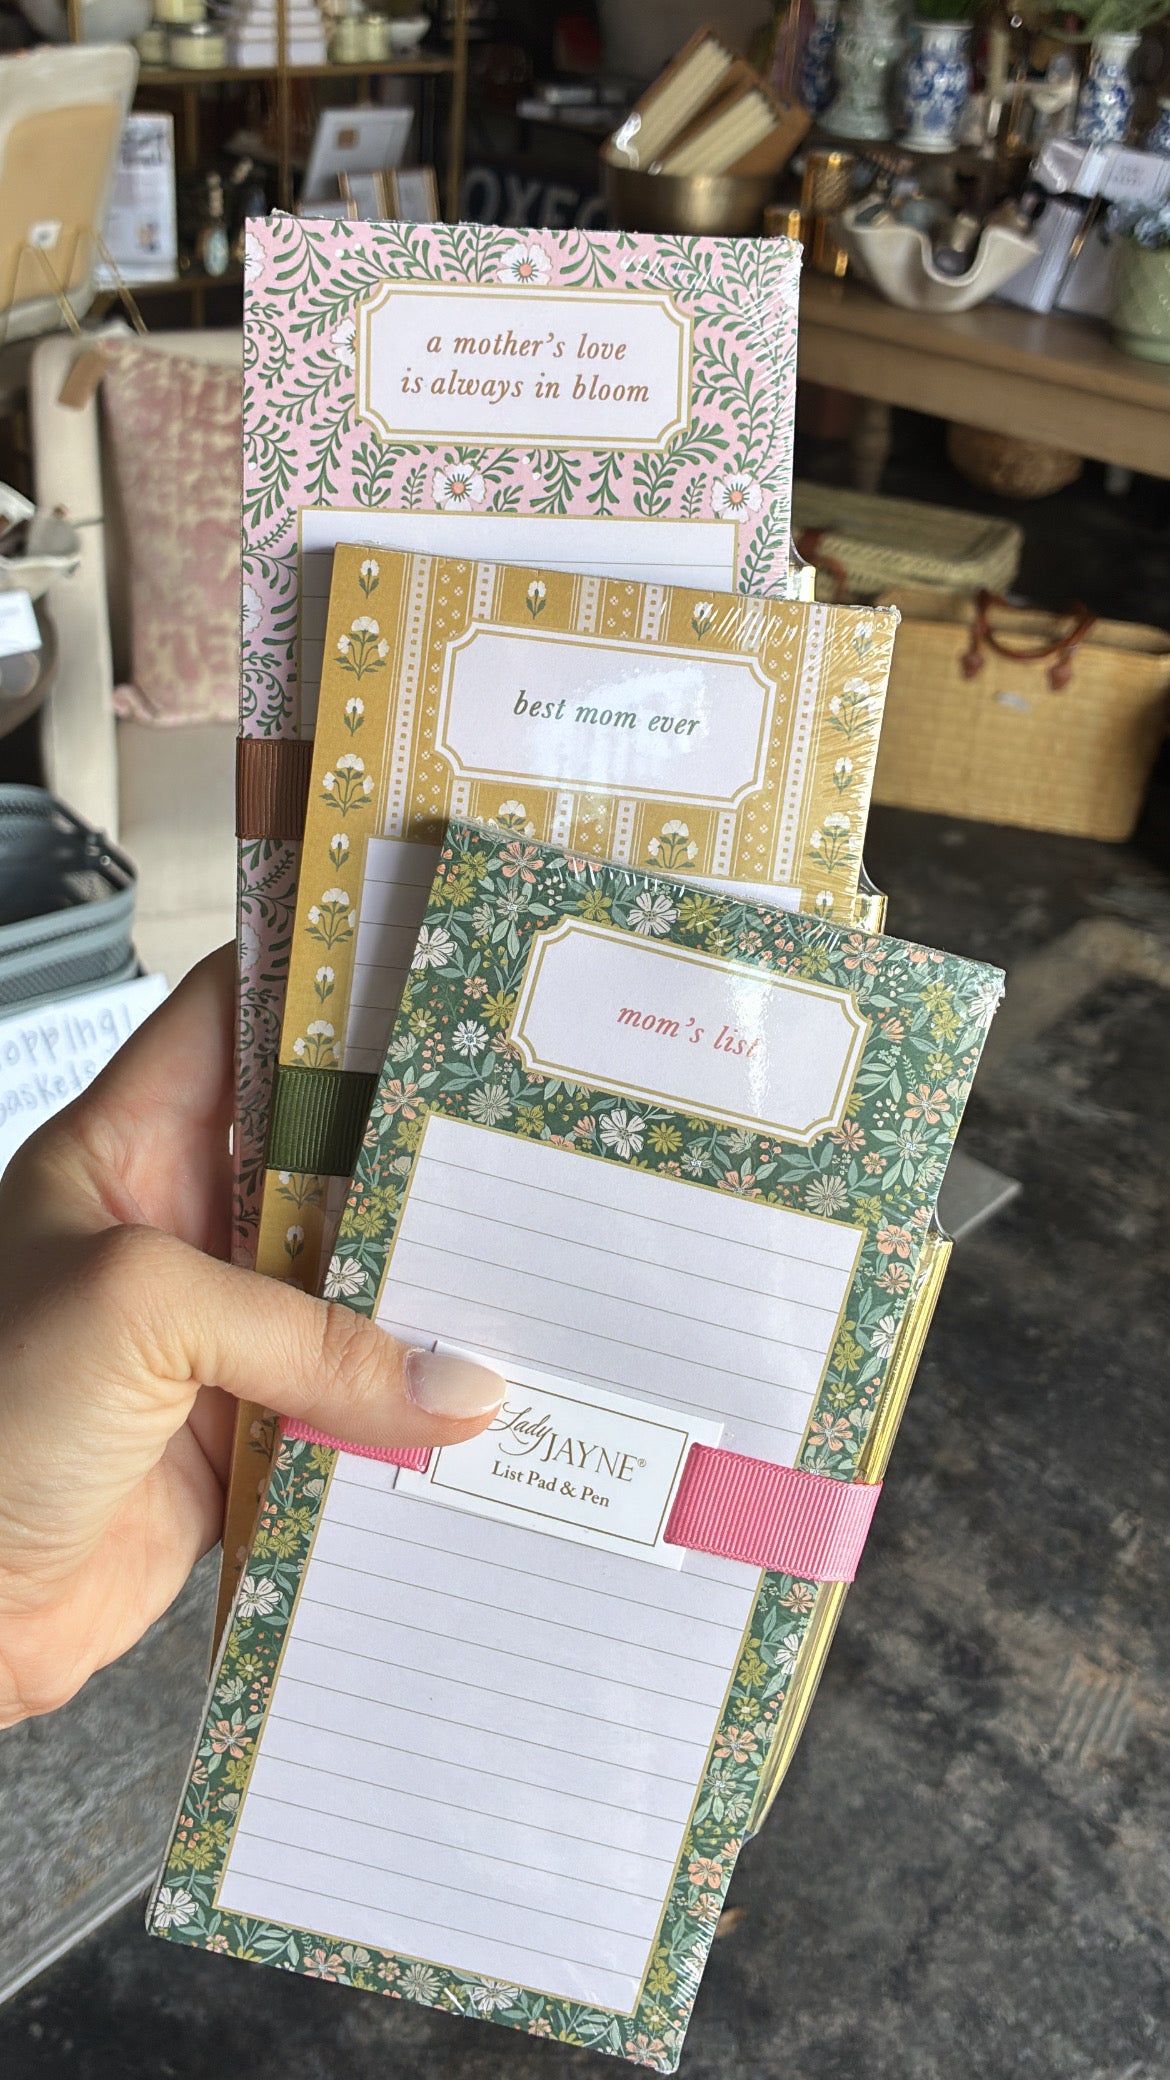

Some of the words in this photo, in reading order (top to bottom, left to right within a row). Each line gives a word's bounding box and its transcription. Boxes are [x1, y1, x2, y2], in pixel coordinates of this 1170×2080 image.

[426, 335, 442, 353] a
[453, 330, 566, 358] mother's
[577, 332, 627, 360] love
[401, 367, 424, 394] is
[430, 369, 524, 405] always
[535, 372, 560, 399] in
[572, 373, 650, 402] bloom
[513, 690, 566, 720] best
[575, 705, 637, 729] mom
[648, 714, 700, 736] ever
[616, 1007, 705, 1043] mom's
[713, 1025, 760, 1058] list
[487, 1402, 552, 1456] Lady
[491, 1460, 524, 1483] List
[526, 1470, 557, 1492] Pad
[560, 1481, 577, 1498] &
[580, 1486, 610, 1507] Pen
